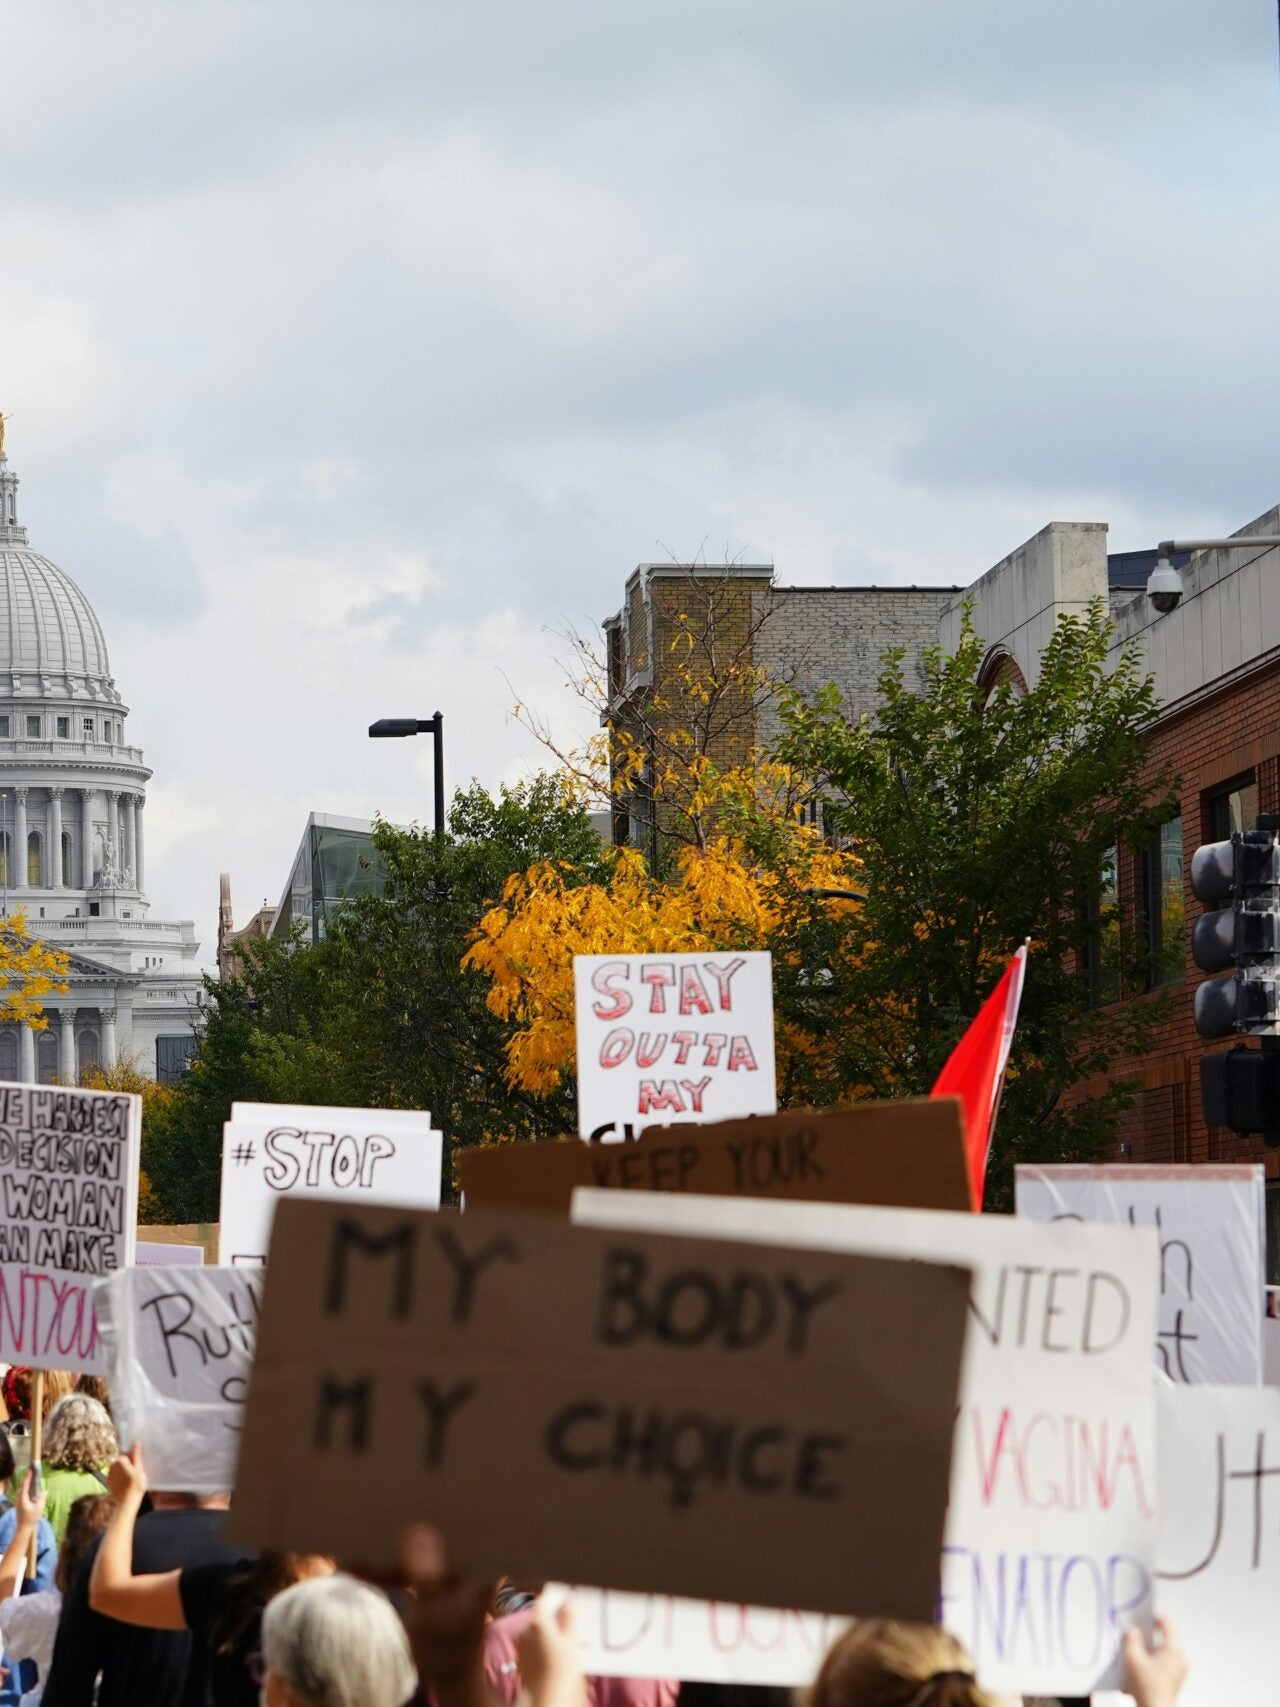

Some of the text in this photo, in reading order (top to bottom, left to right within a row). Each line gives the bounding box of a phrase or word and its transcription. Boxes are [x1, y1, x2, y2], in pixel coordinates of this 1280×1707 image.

[591, 958, 747, 1021] STAY
[599, 1026, 759, 1072] OUTTA
[29, 1090, 132, 1141] HARDEST
[637, 1076, 712, 1115] MY
[725, 1126, 825, 1188] YOUR
[2, 1173, 124, 1233] WOMAN
[35, 1228, 118, 1276] MAKE
[315, 1213, 842, 1362] MY BODY
[969, 1266, 1132, 1355] NTED
[311, 1370, 477, 1472] MY
[545, 1399, 852, 1508] CHOICE
[969, 1405, 1154, 1520] VAGINA
